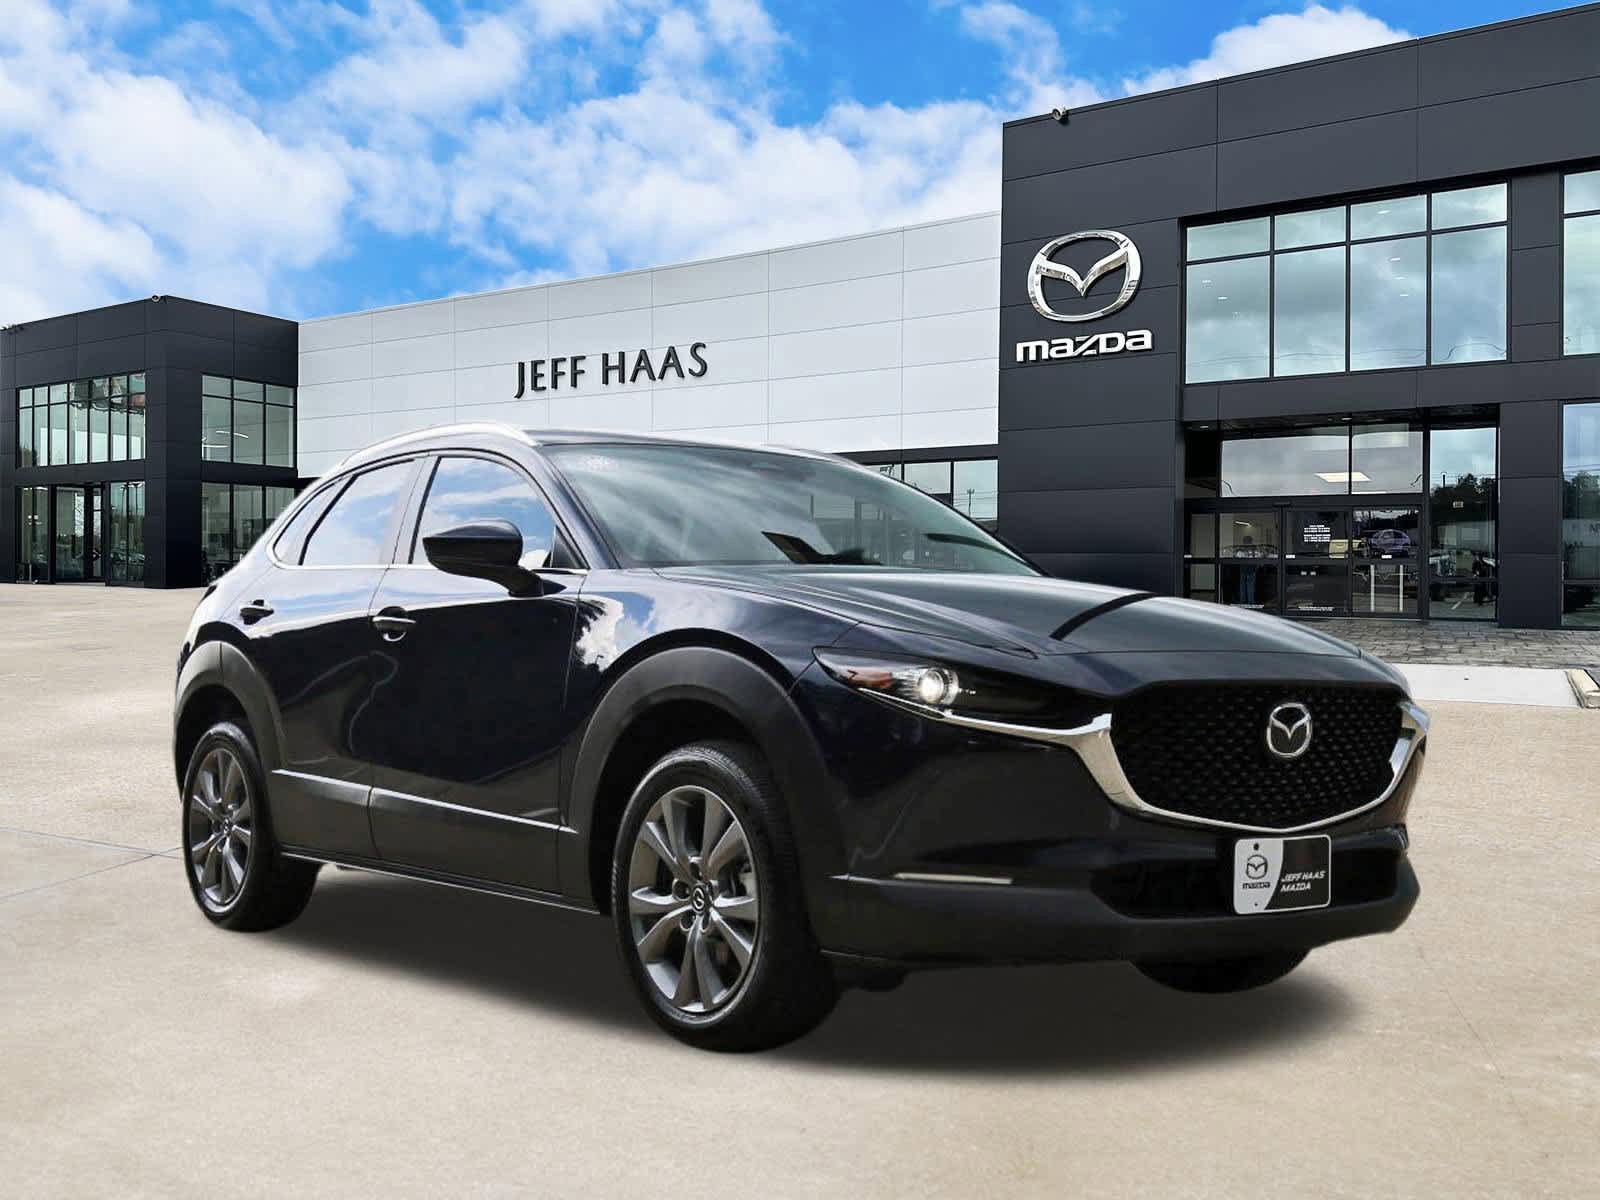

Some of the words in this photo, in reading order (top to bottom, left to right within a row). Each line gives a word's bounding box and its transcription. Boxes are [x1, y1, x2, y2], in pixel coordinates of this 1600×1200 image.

[1016, 329, 1153, 362] mazda
[513, 355, 587, 399] JEFF
[601, 342, 708, 386] HAAS
[1280, 881, 1312, 892] MAZDA
[1281, 872, 1302, 882] JEFF
[1302, 870, 1326, 880] HAAS
